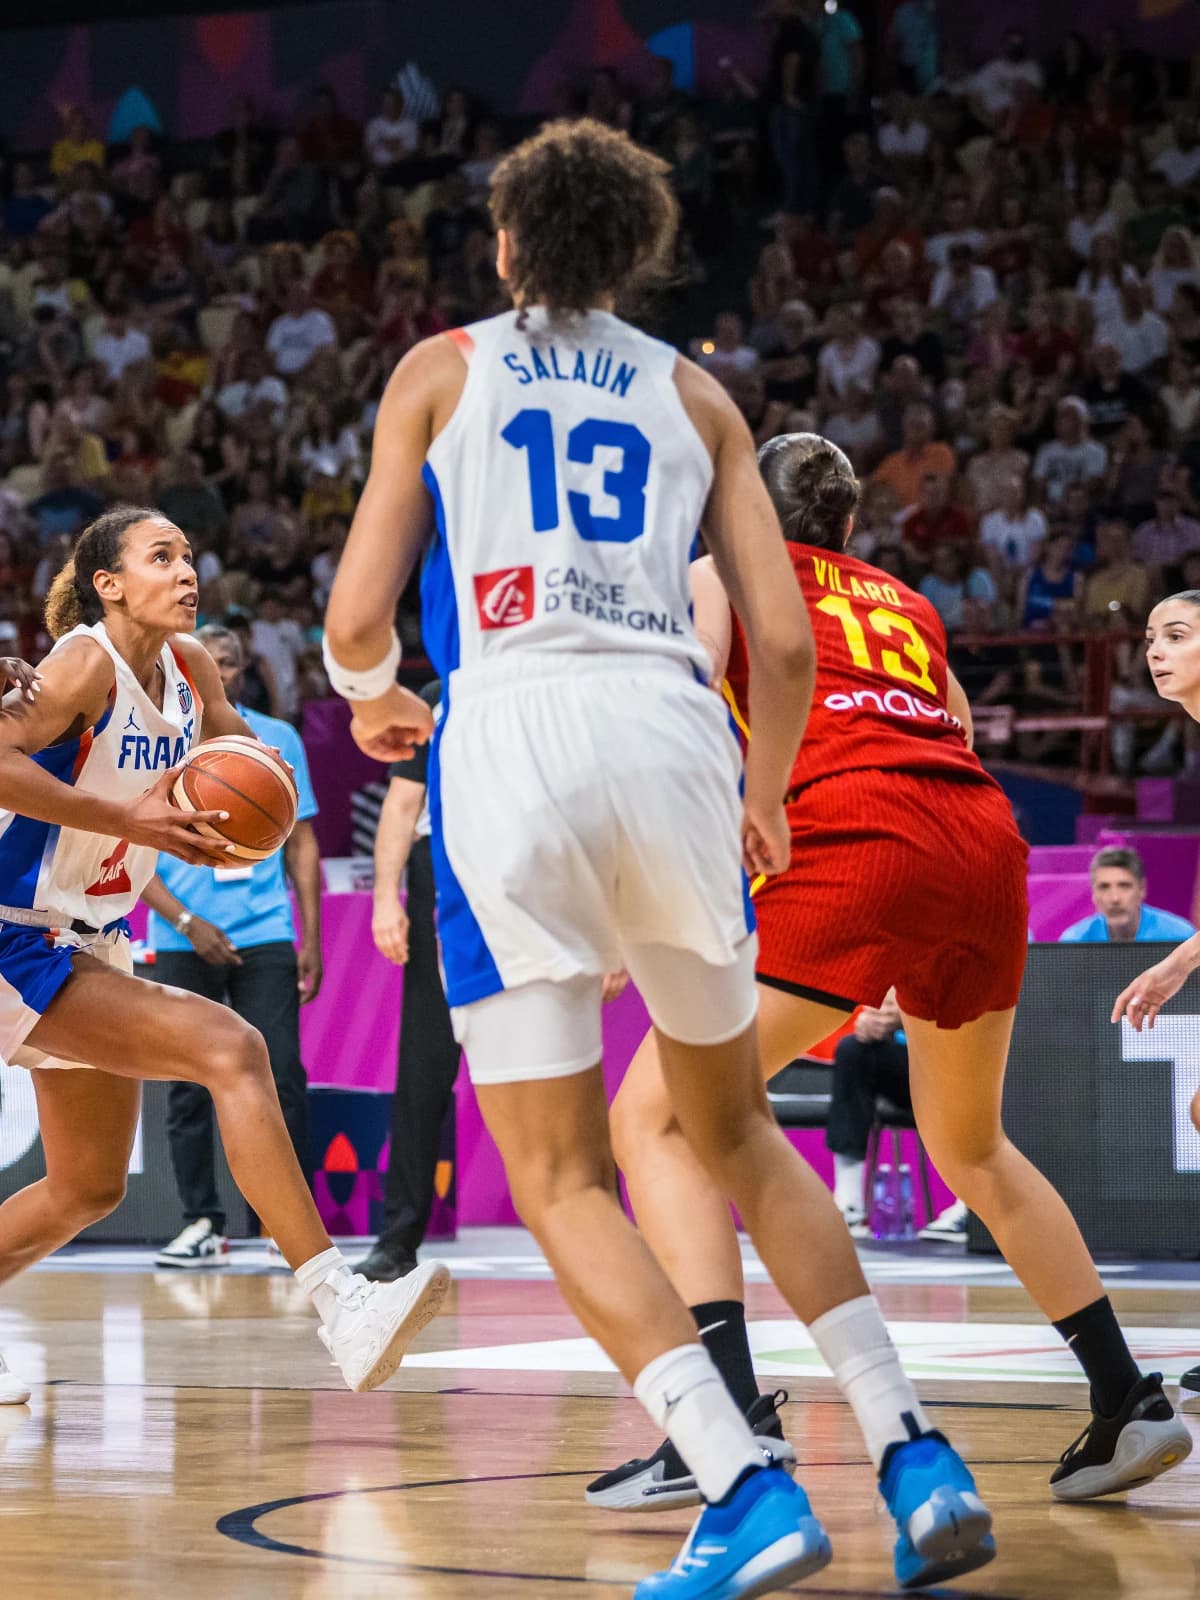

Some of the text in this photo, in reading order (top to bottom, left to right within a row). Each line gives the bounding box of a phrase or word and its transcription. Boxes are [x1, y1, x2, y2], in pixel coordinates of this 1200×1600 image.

[503, 346, 637, 398] SALAÜN
[500, 409, 651, 543] 13
[545, 567, 625, 605] CAISE
[816, 595, 937, 695] 13
